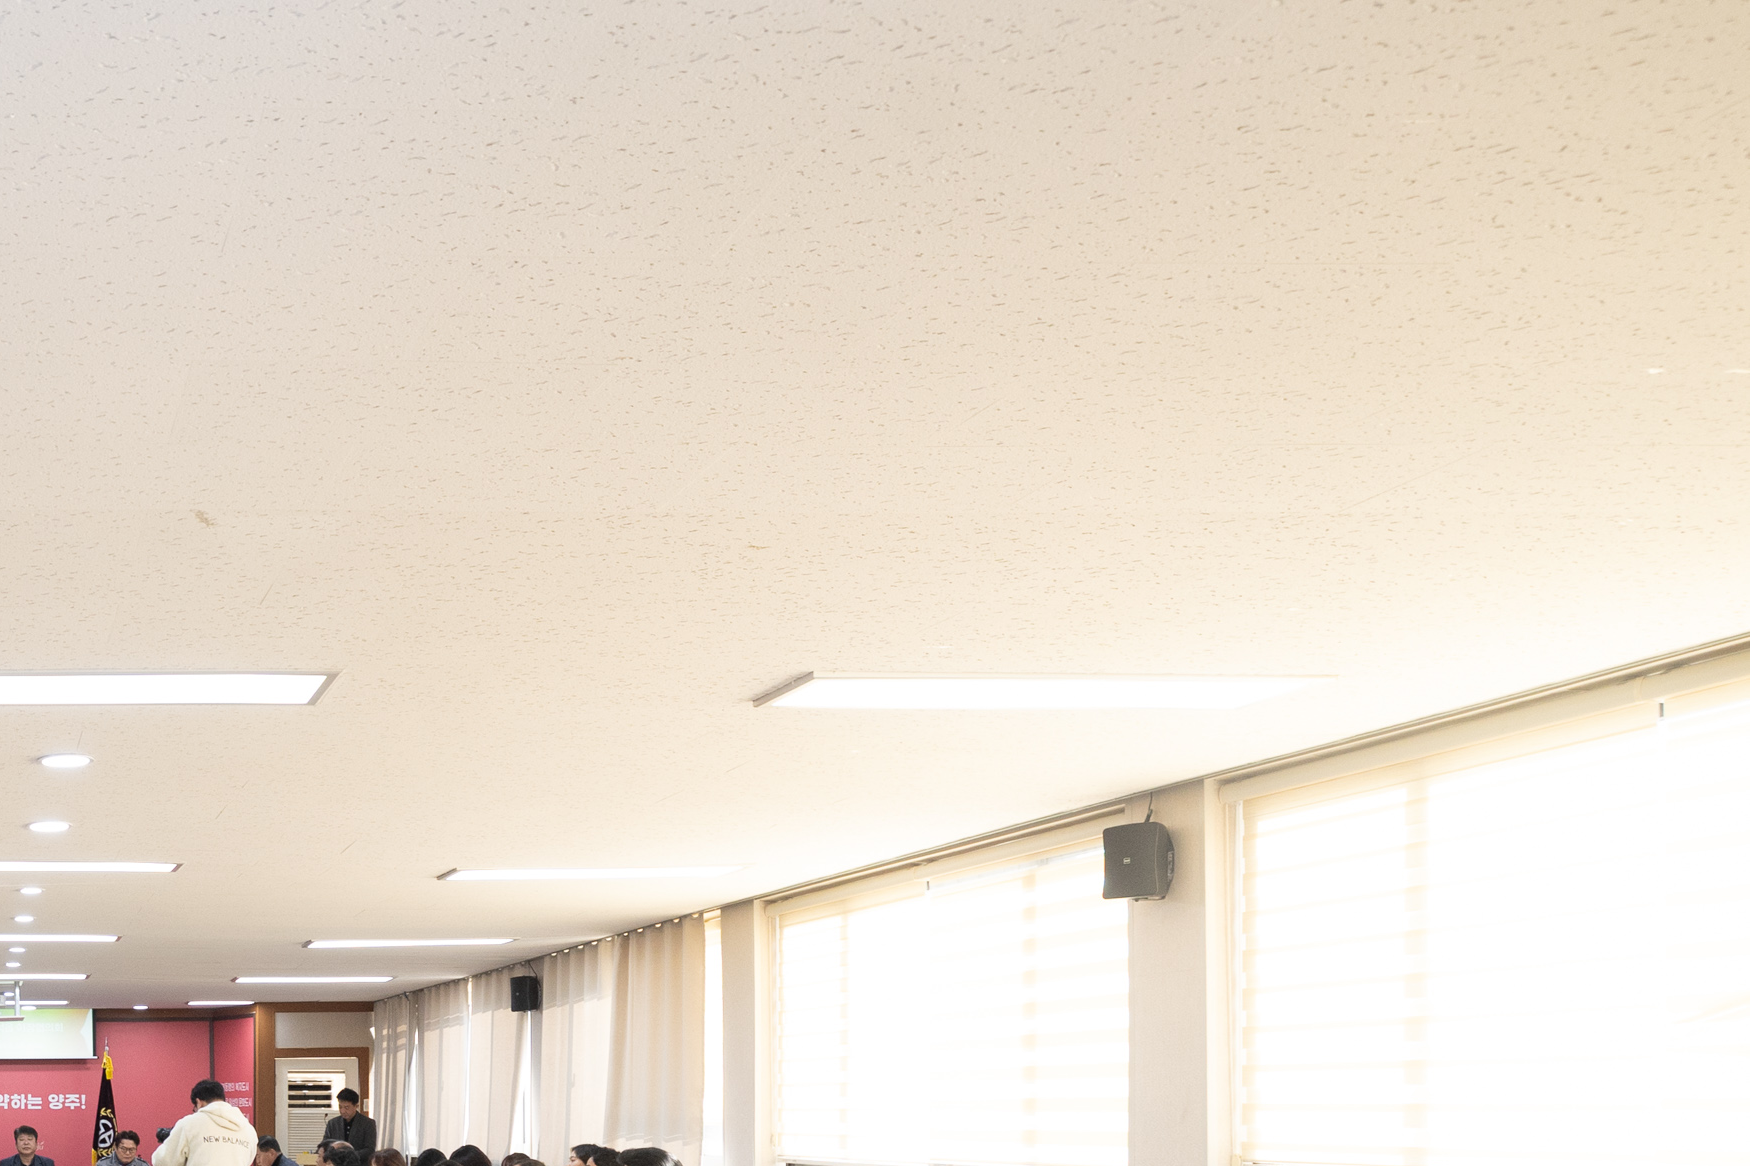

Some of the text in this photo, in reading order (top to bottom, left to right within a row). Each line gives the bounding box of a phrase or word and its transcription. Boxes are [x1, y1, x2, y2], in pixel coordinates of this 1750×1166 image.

[47, 1093, 86, 1110] 양주!
[203, 1135, 249, 1149] NEW BALANCE
